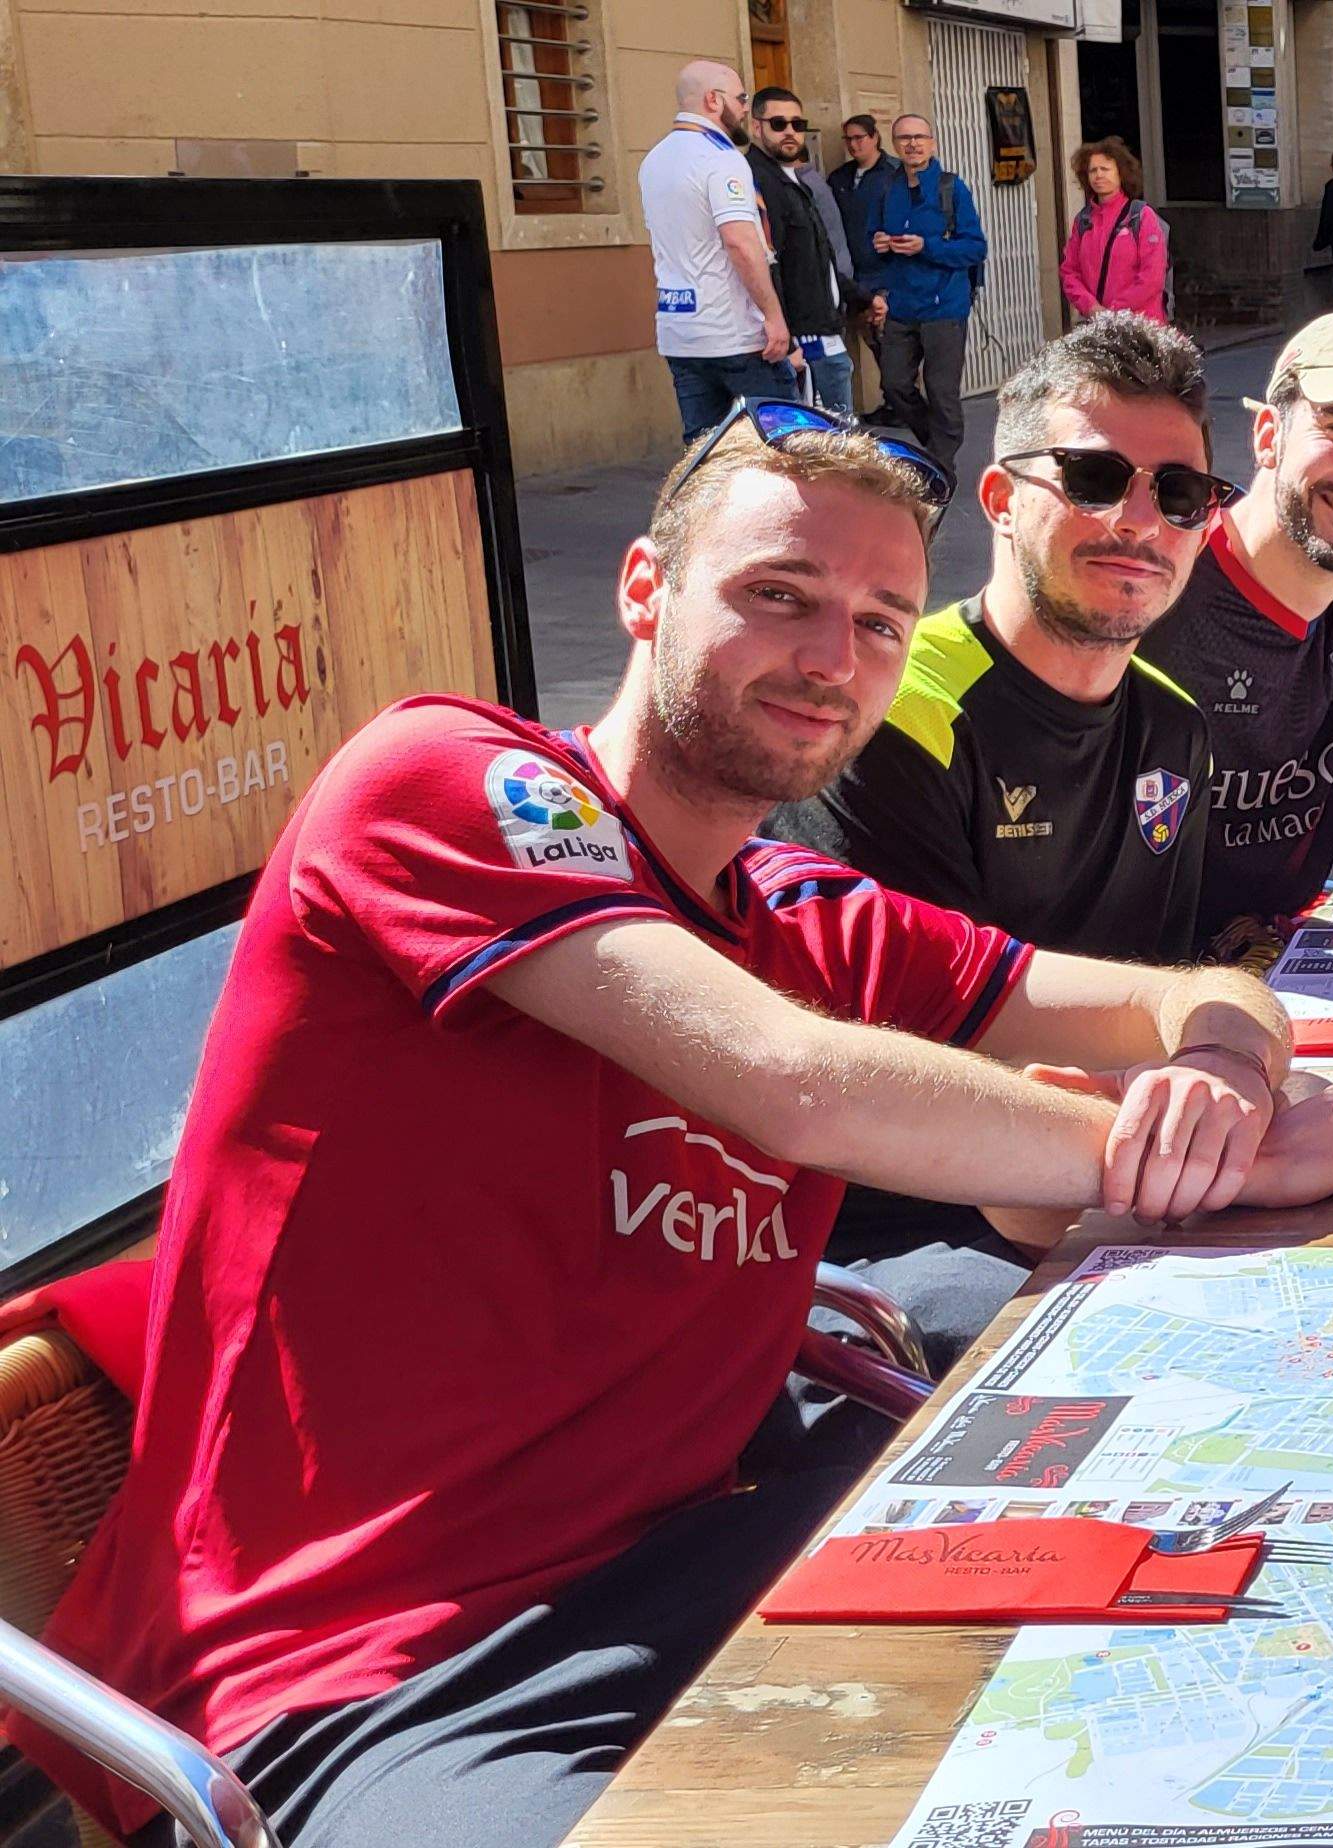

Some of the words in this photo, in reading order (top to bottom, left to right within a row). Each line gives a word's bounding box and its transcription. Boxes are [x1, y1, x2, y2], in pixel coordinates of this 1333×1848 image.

[1213, 701, 1261, 715] KELME
[77, 739, 290, 853] RESTO-BAR
[525, 836, 619, 868] LaLiga
[944, 1566, 991, 1576] RESTO
[1000, 1566, 1032, 1576] BAR
[1083, 1826, 1130, 1837] MENÚ
[1131, 1828, 1159, 1837] DEL
[1161, 1826, 1188, 1837] DÍA
[1195, 1826, 1289, 1836] ALMUERZOS
[1081, 1837, 1130, 1847] TAPAS
[1141, 1836, 1218, 1846] TOSTADAS
[1228, 1833, 1302, 1843] RACIONES
